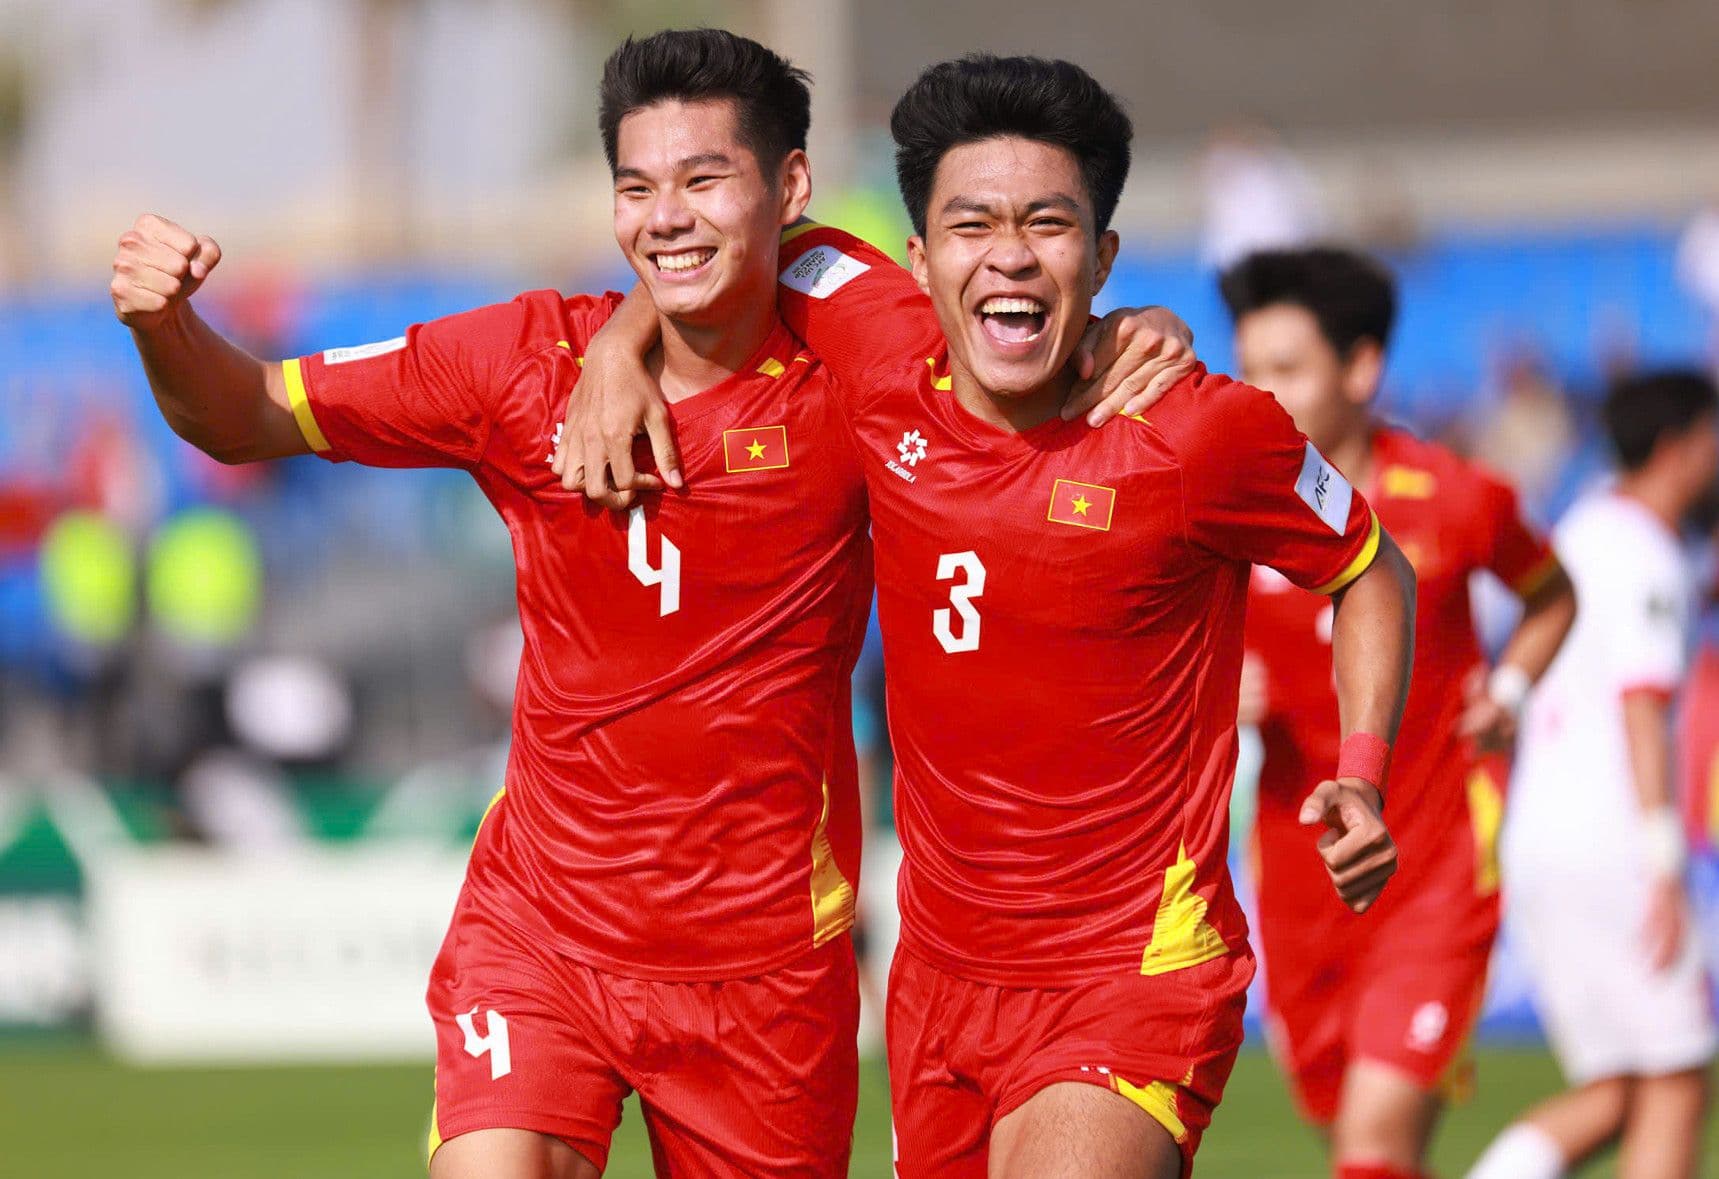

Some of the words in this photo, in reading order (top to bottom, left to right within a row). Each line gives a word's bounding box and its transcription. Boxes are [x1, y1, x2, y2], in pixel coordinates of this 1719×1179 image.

[1314, 464, 1331, 511] AFC
[628, 504, 681, 617] 4
[933, 550, 987, 654] 3
[455, 1004, 512, 1081] 4
